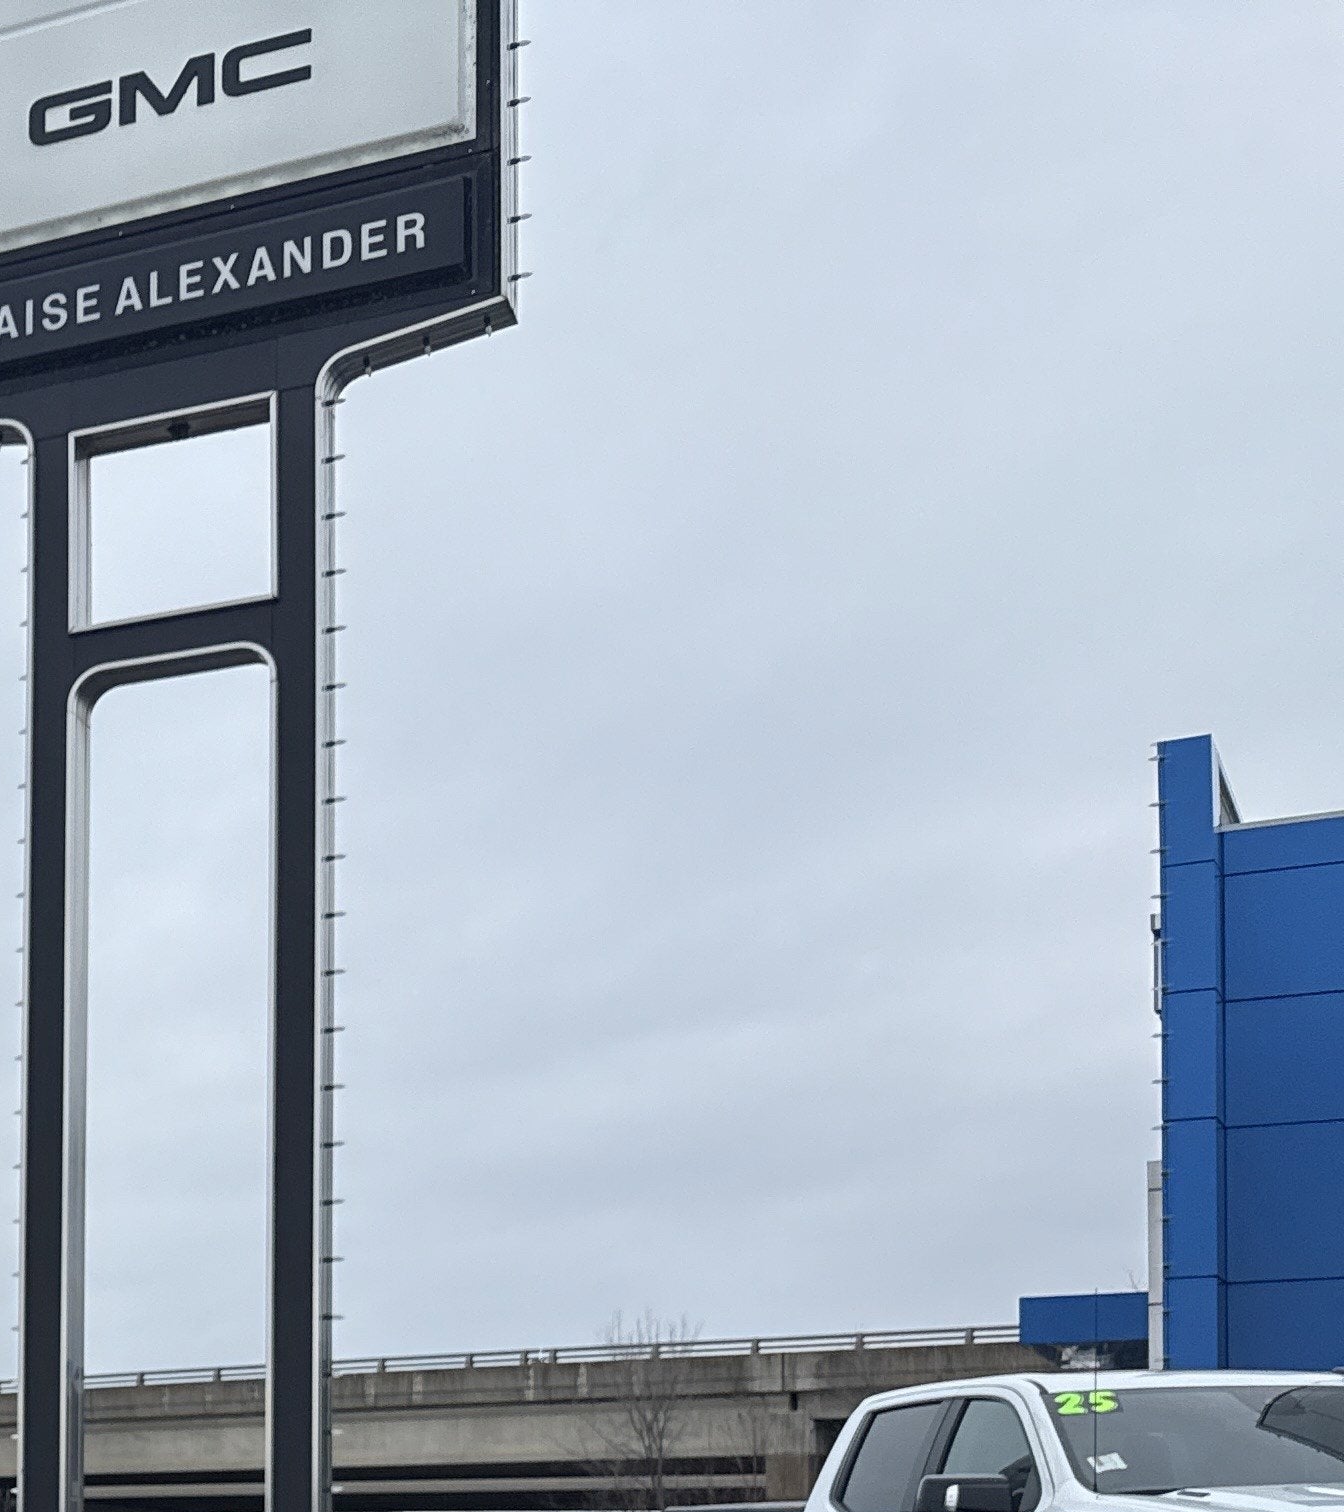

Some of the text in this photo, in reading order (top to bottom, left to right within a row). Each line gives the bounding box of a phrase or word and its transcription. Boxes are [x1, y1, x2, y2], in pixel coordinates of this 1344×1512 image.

[29, 28, 312, 146] GMC
[114, 212, 427, 317] ALEXANDER
[1054, 1391, 1119, 1415] 25
